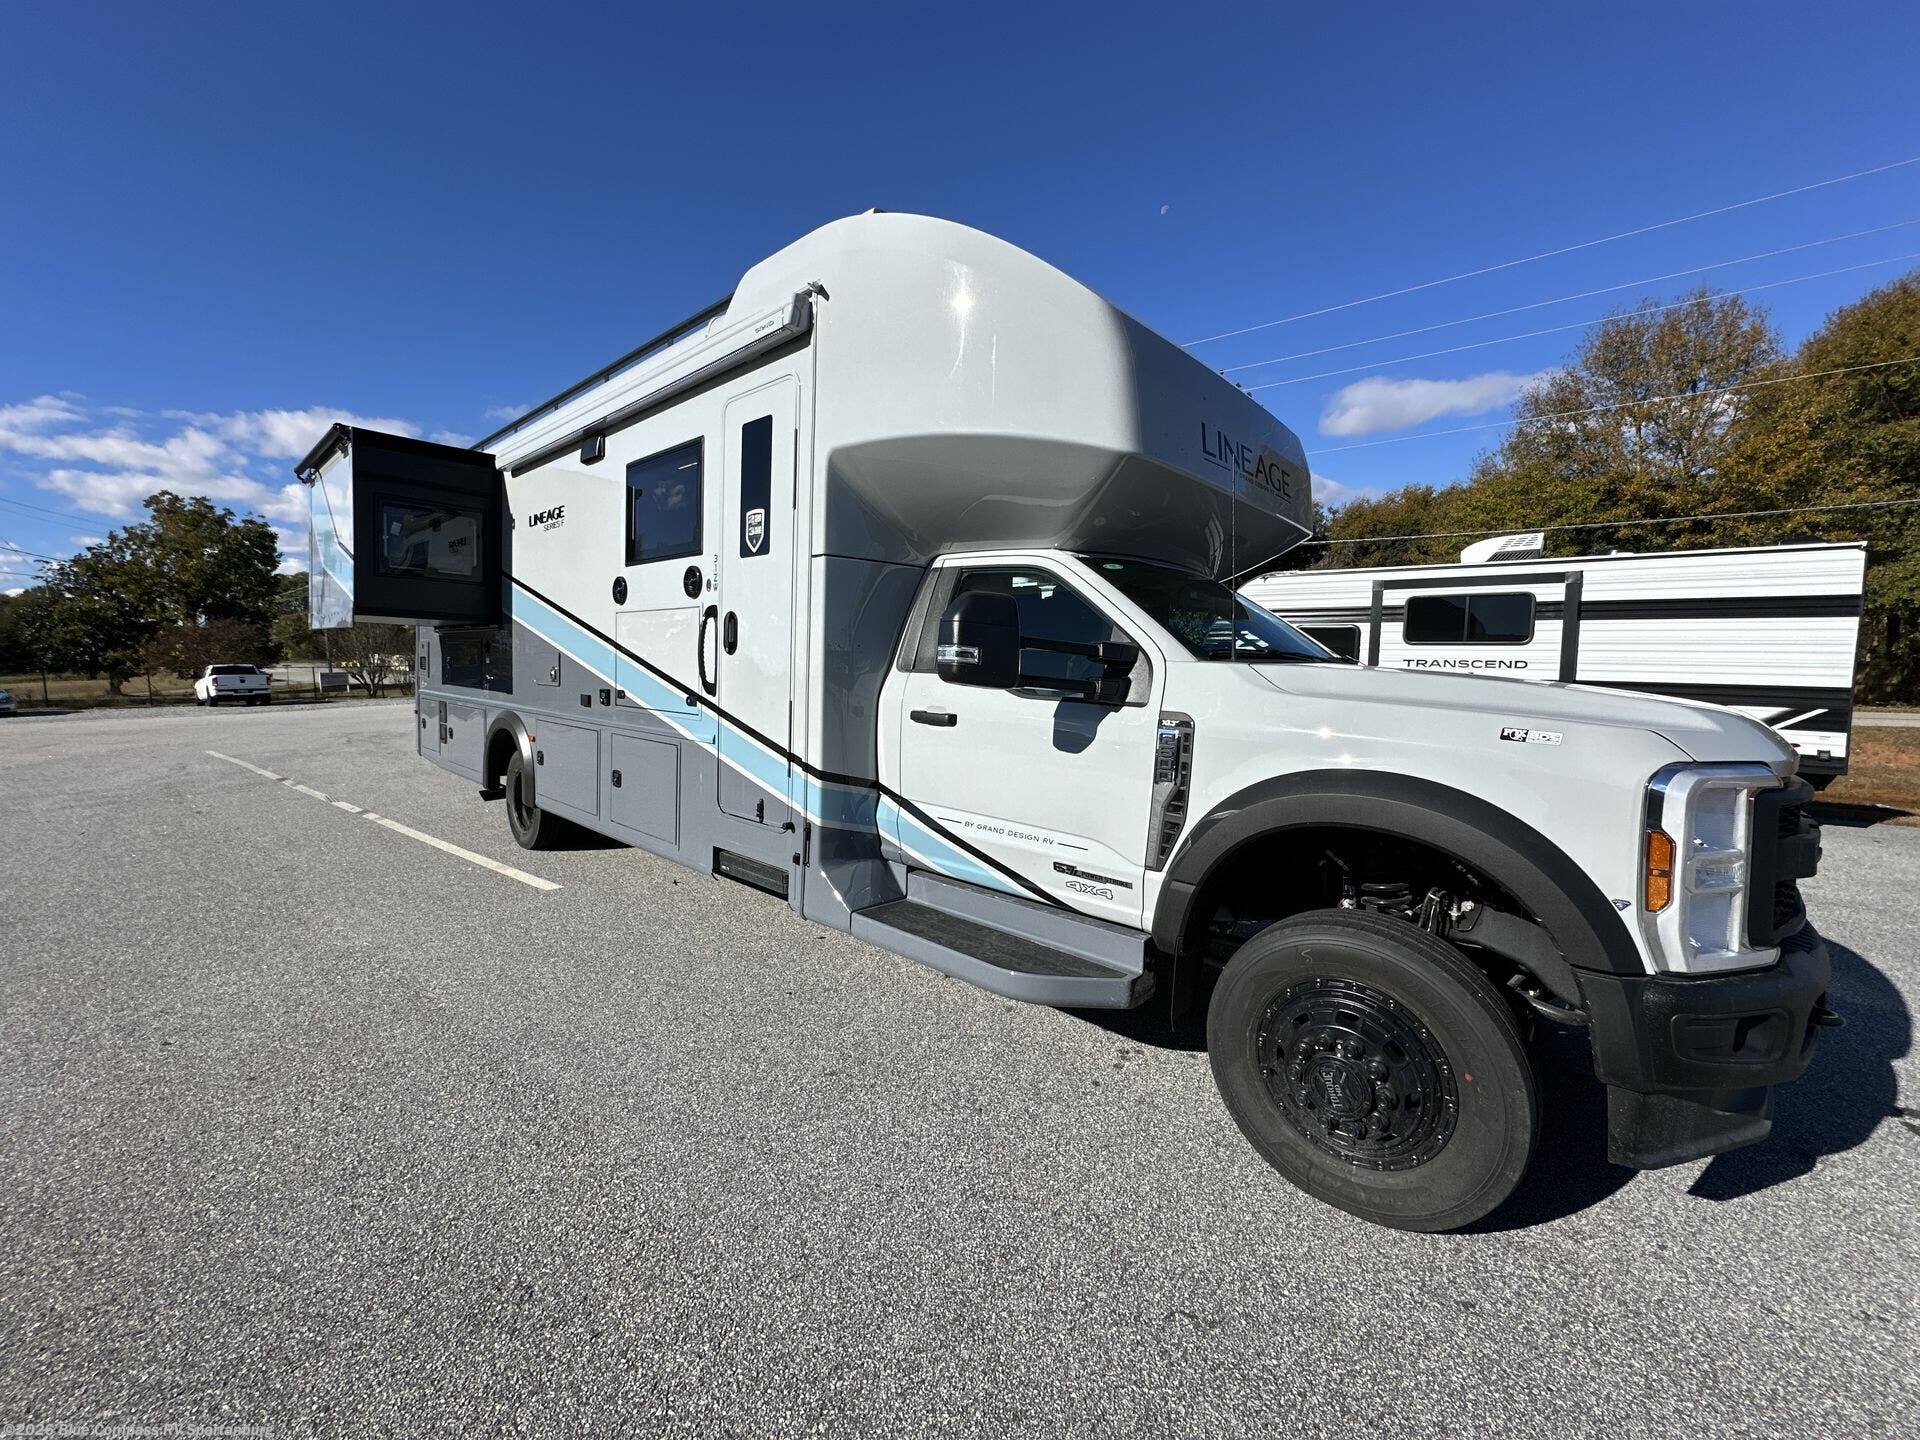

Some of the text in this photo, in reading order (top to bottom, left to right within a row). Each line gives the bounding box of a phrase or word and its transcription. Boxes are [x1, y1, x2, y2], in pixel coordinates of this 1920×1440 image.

[1201, 422, 1292, 498] LINEAGE
[528, 505, 565, 527] LINEAGE
[543, 520, 561, 531] SERIES
[1402, 659, 1529, 669] TRANSCEND
[1502, 727, 1529, 742] FOX
[964, 820, 1055, 845] BY GRAND DESIGN RV
